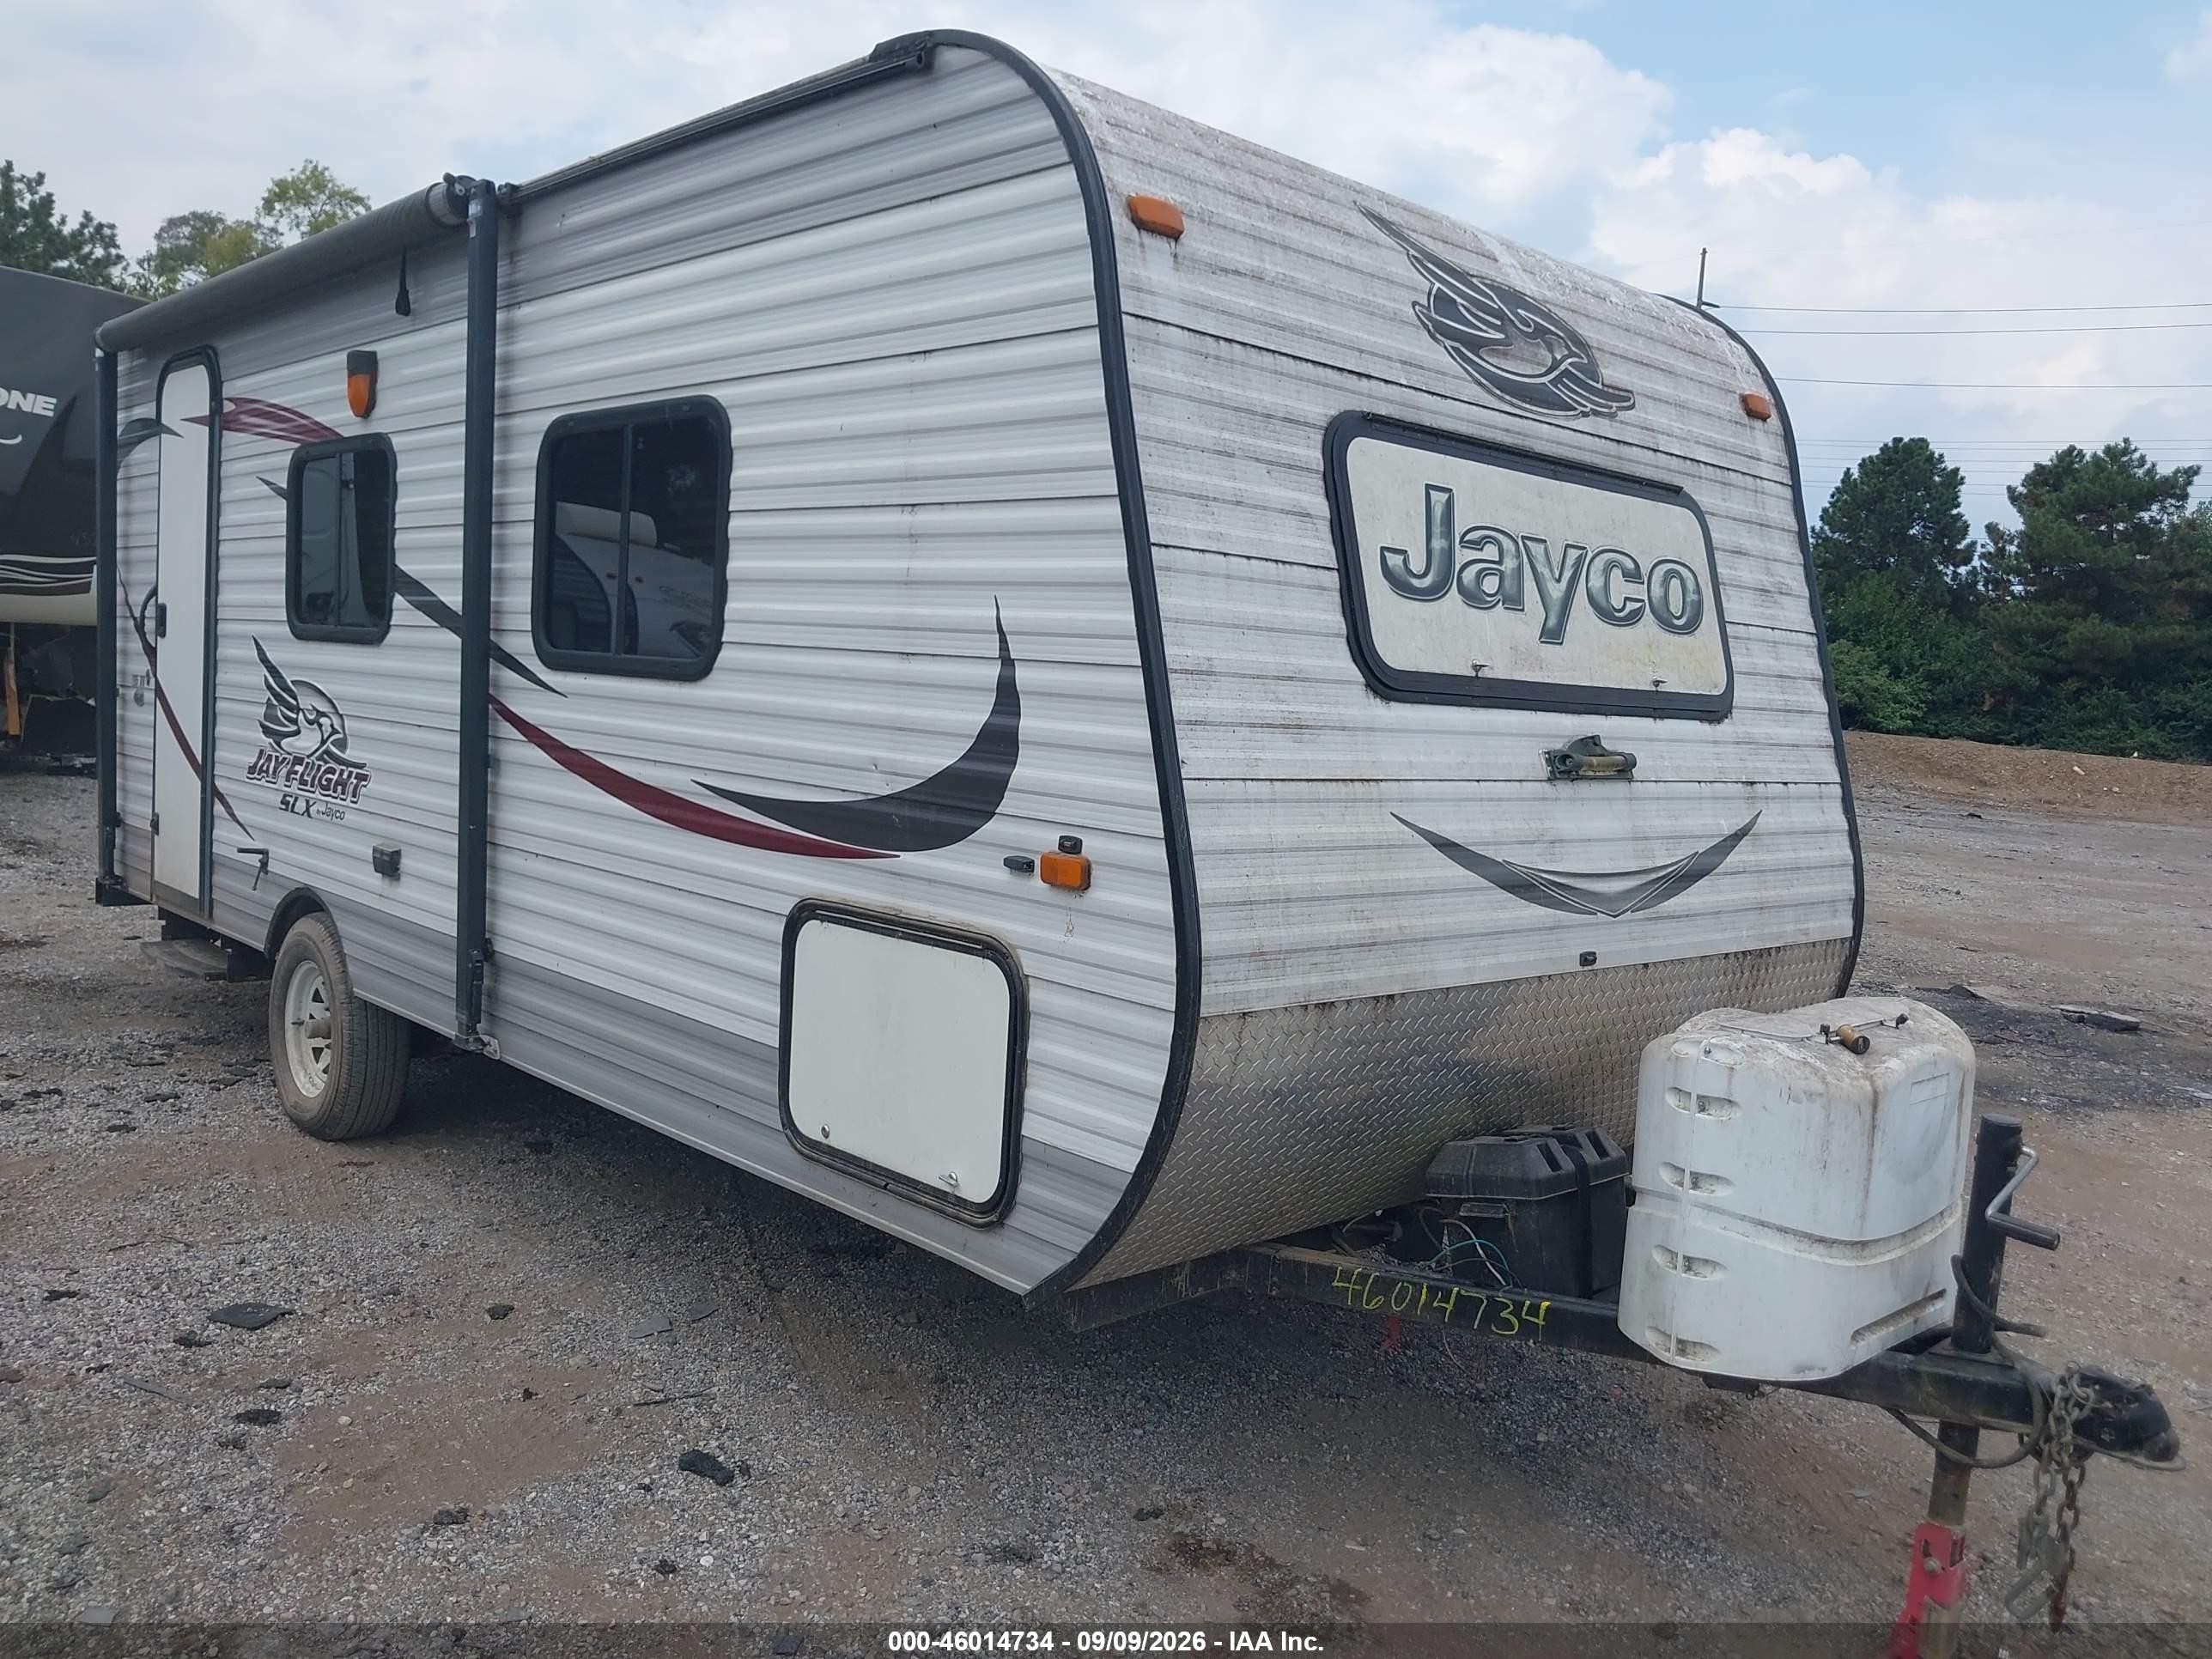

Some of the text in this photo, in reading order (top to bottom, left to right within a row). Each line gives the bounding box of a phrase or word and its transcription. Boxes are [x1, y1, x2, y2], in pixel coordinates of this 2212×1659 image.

[1379, 481, 1705, 647] Jayco
[246, 748, 371, 805] JAY FLIGHT
[278, 793, 346, 822] SLX Jayco
[1331, 1266, 1552, 1341] 46014734
